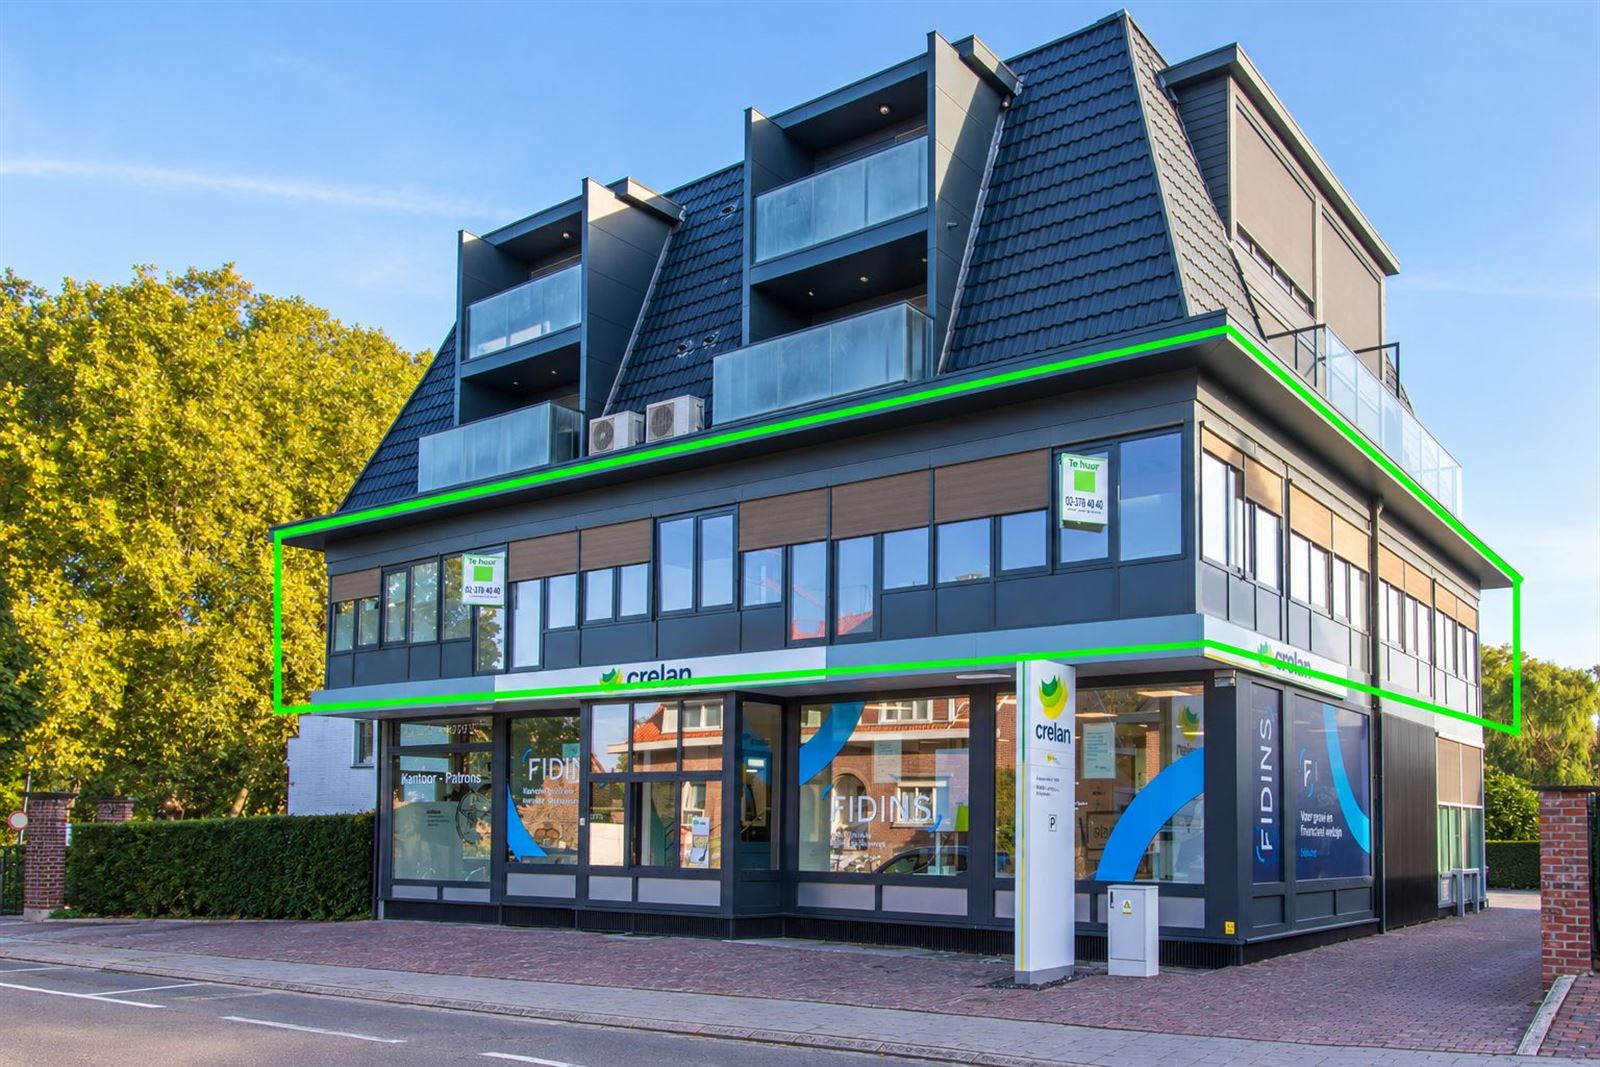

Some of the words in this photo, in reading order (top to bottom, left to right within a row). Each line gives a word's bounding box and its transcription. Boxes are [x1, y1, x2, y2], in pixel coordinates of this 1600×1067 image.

[1087, 499, 1095, 509] 40
[1095, 499, 1104, 510] 40
[627, 663, 692, 684] crelan
[1035, 722, 1071, 744] crelan
[401, 773, 437, 785] Kantoor
[445, 771, 482, 784] Patrons
[1260, 718, 1273, 850] FIDINS
[830, 795, 932, 823] FIDINS
[1050, 817, 1056, 829] P
